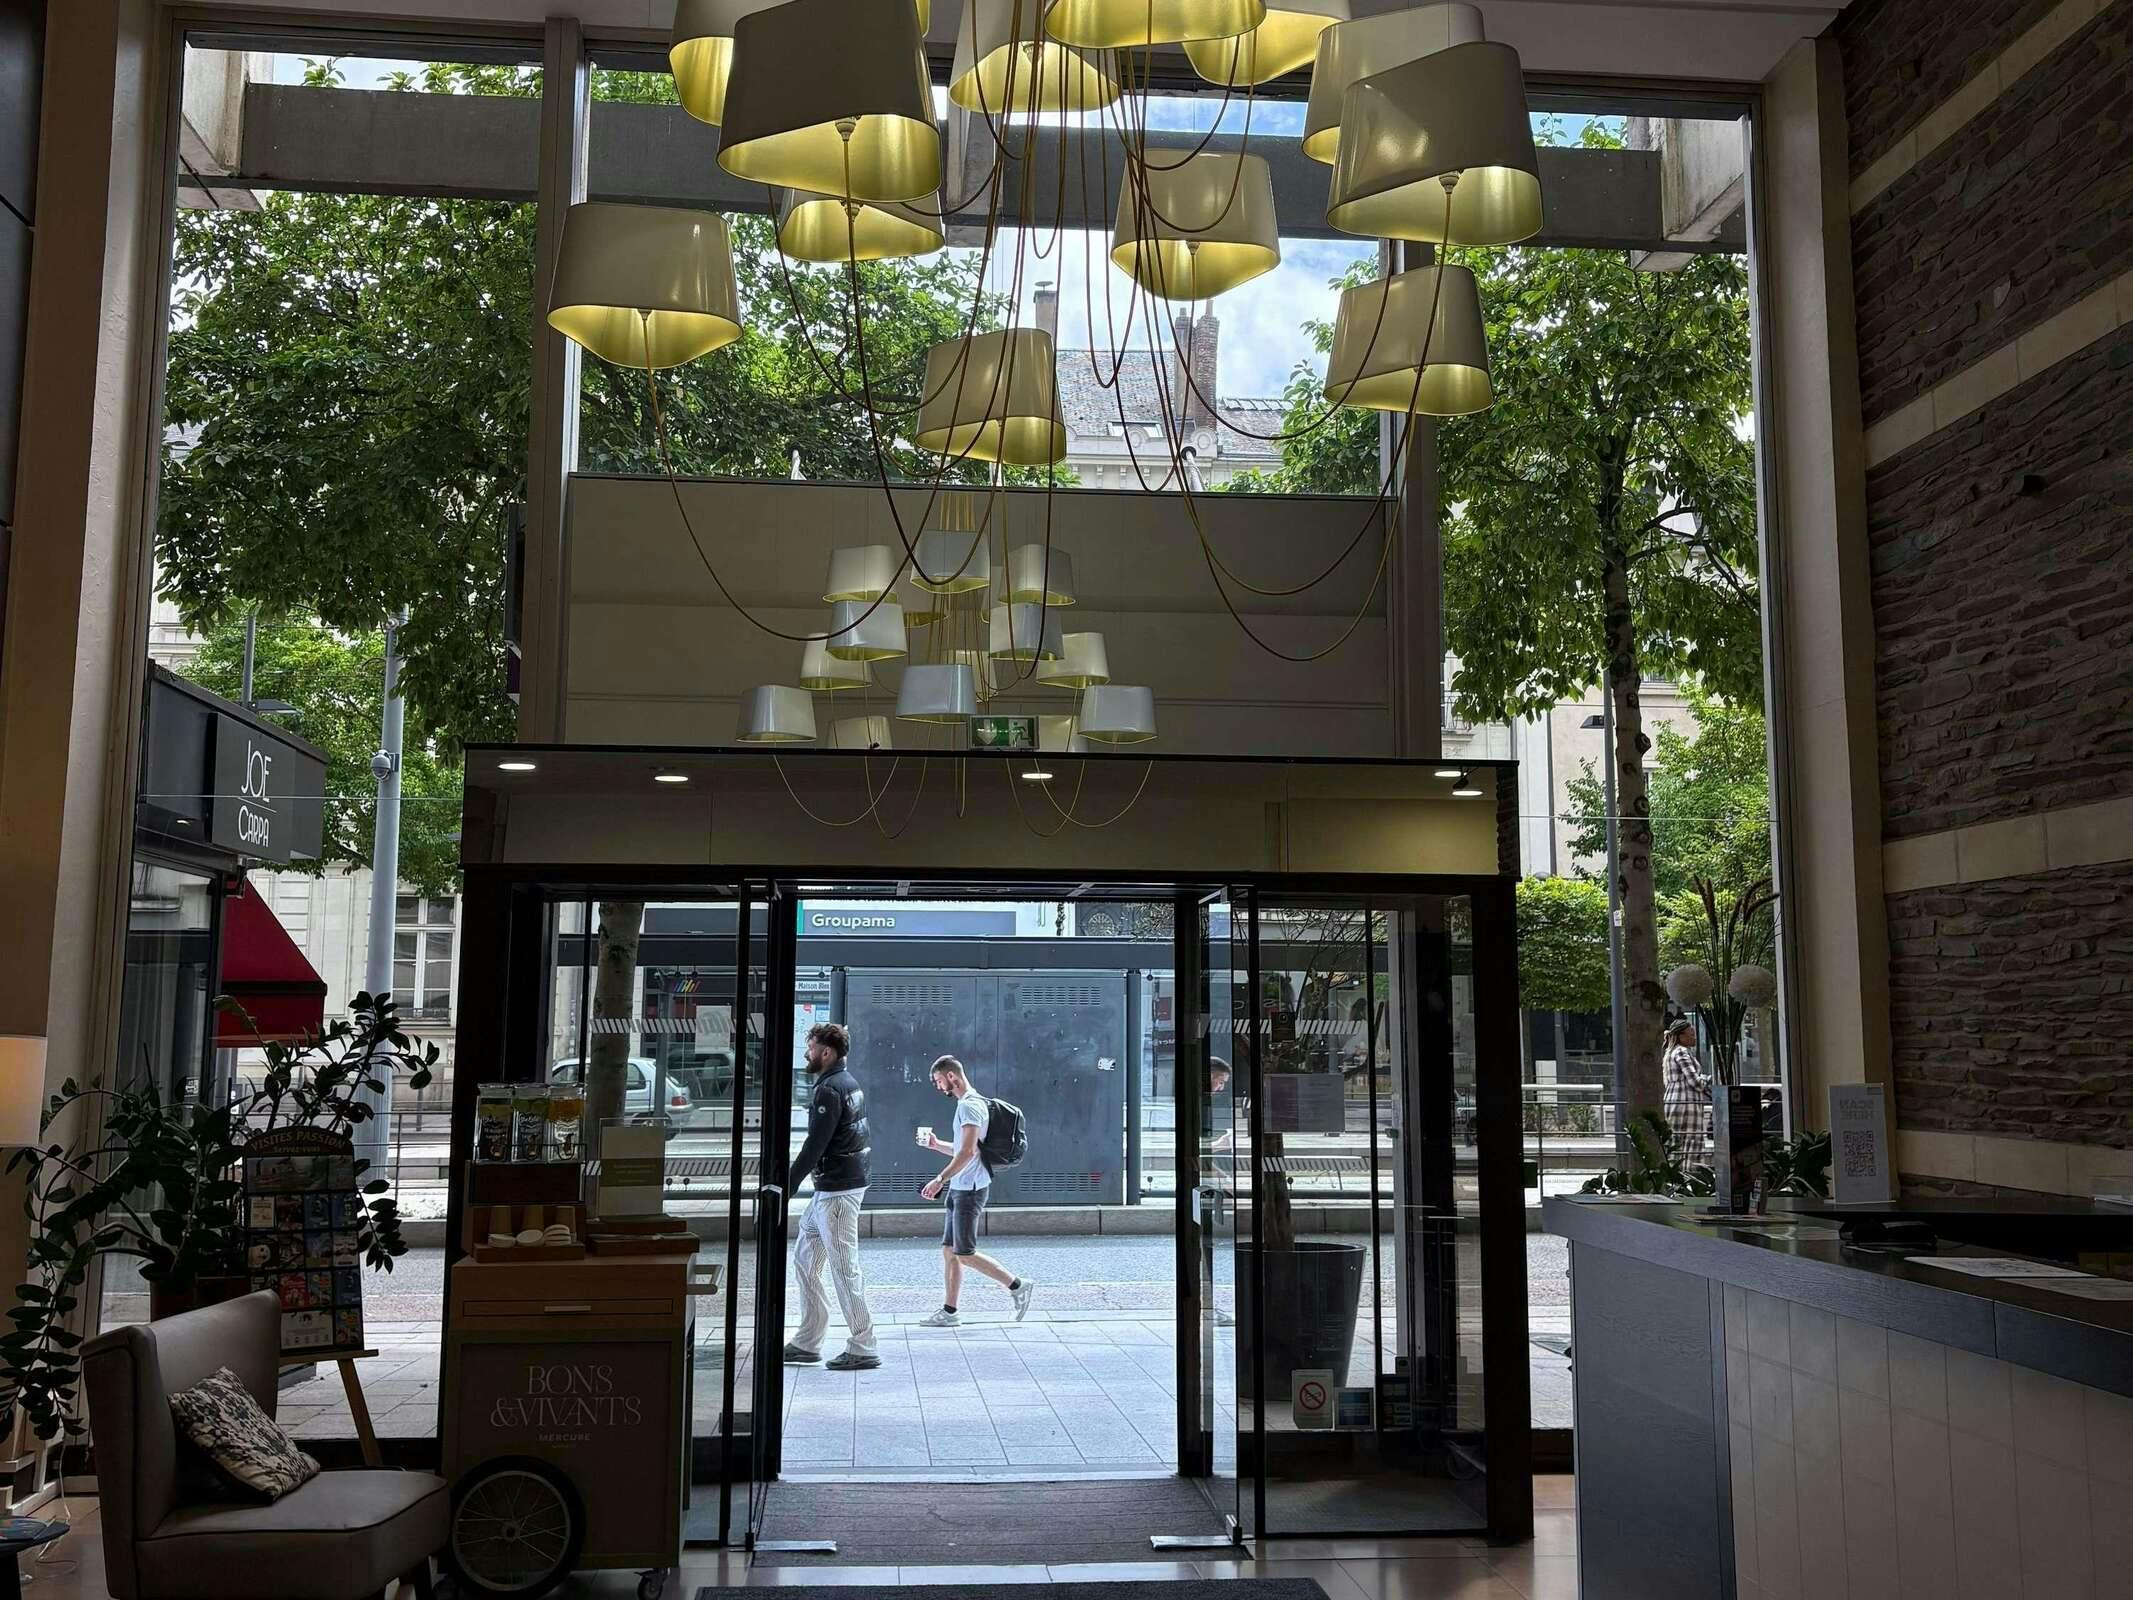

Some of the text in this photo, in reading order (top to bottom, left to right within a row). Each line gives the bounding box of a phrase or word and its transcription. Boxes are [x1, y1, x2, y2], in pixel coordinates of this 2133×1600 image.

[240, 739, 272, 803] JOE
[811, 913, 896, 929] Groupama
[528, 1364, 614, 1395] BONS
[537, 1431, 593, 1441] MERCURE
